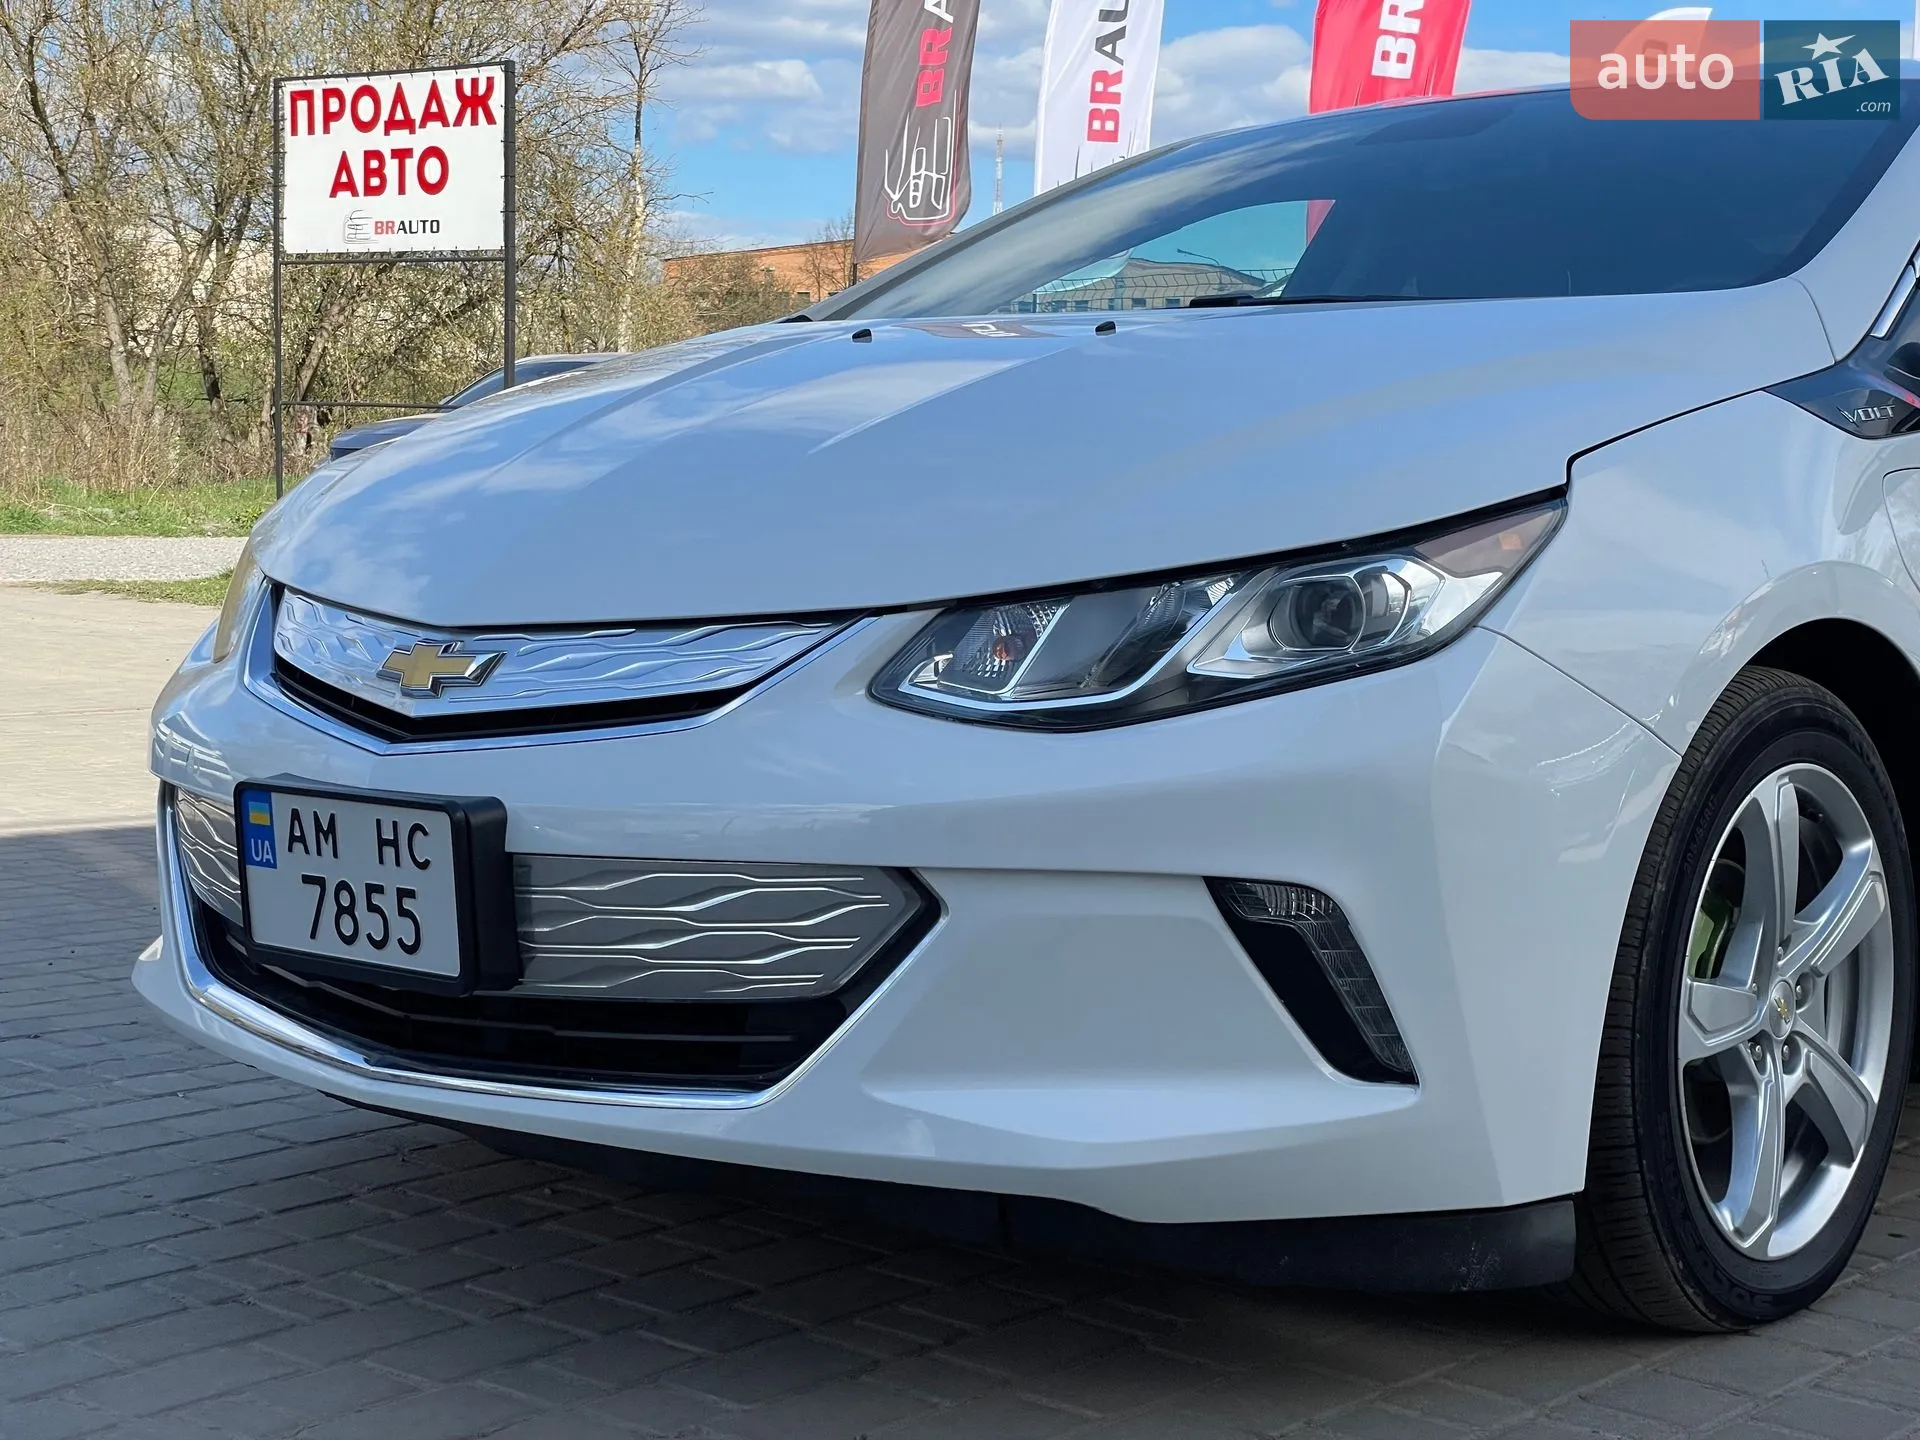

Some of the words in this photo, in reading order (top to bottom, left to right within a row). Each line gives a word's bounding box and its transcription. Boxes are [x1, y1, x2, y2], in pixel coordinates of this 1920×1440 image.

[290, 76, 497, 136] ПРОДАЖ
[329, 145, 449, 198] АВТО
[374, 219, 440, 235] BRAUTO
[1838, 404, 1896, 423] VOLT
[250, 838, 274, 864] UA
[287, 807, 339, 859] AM
[375, 818, 431, 870] HC
[301, 874, 421, 955] 7855
